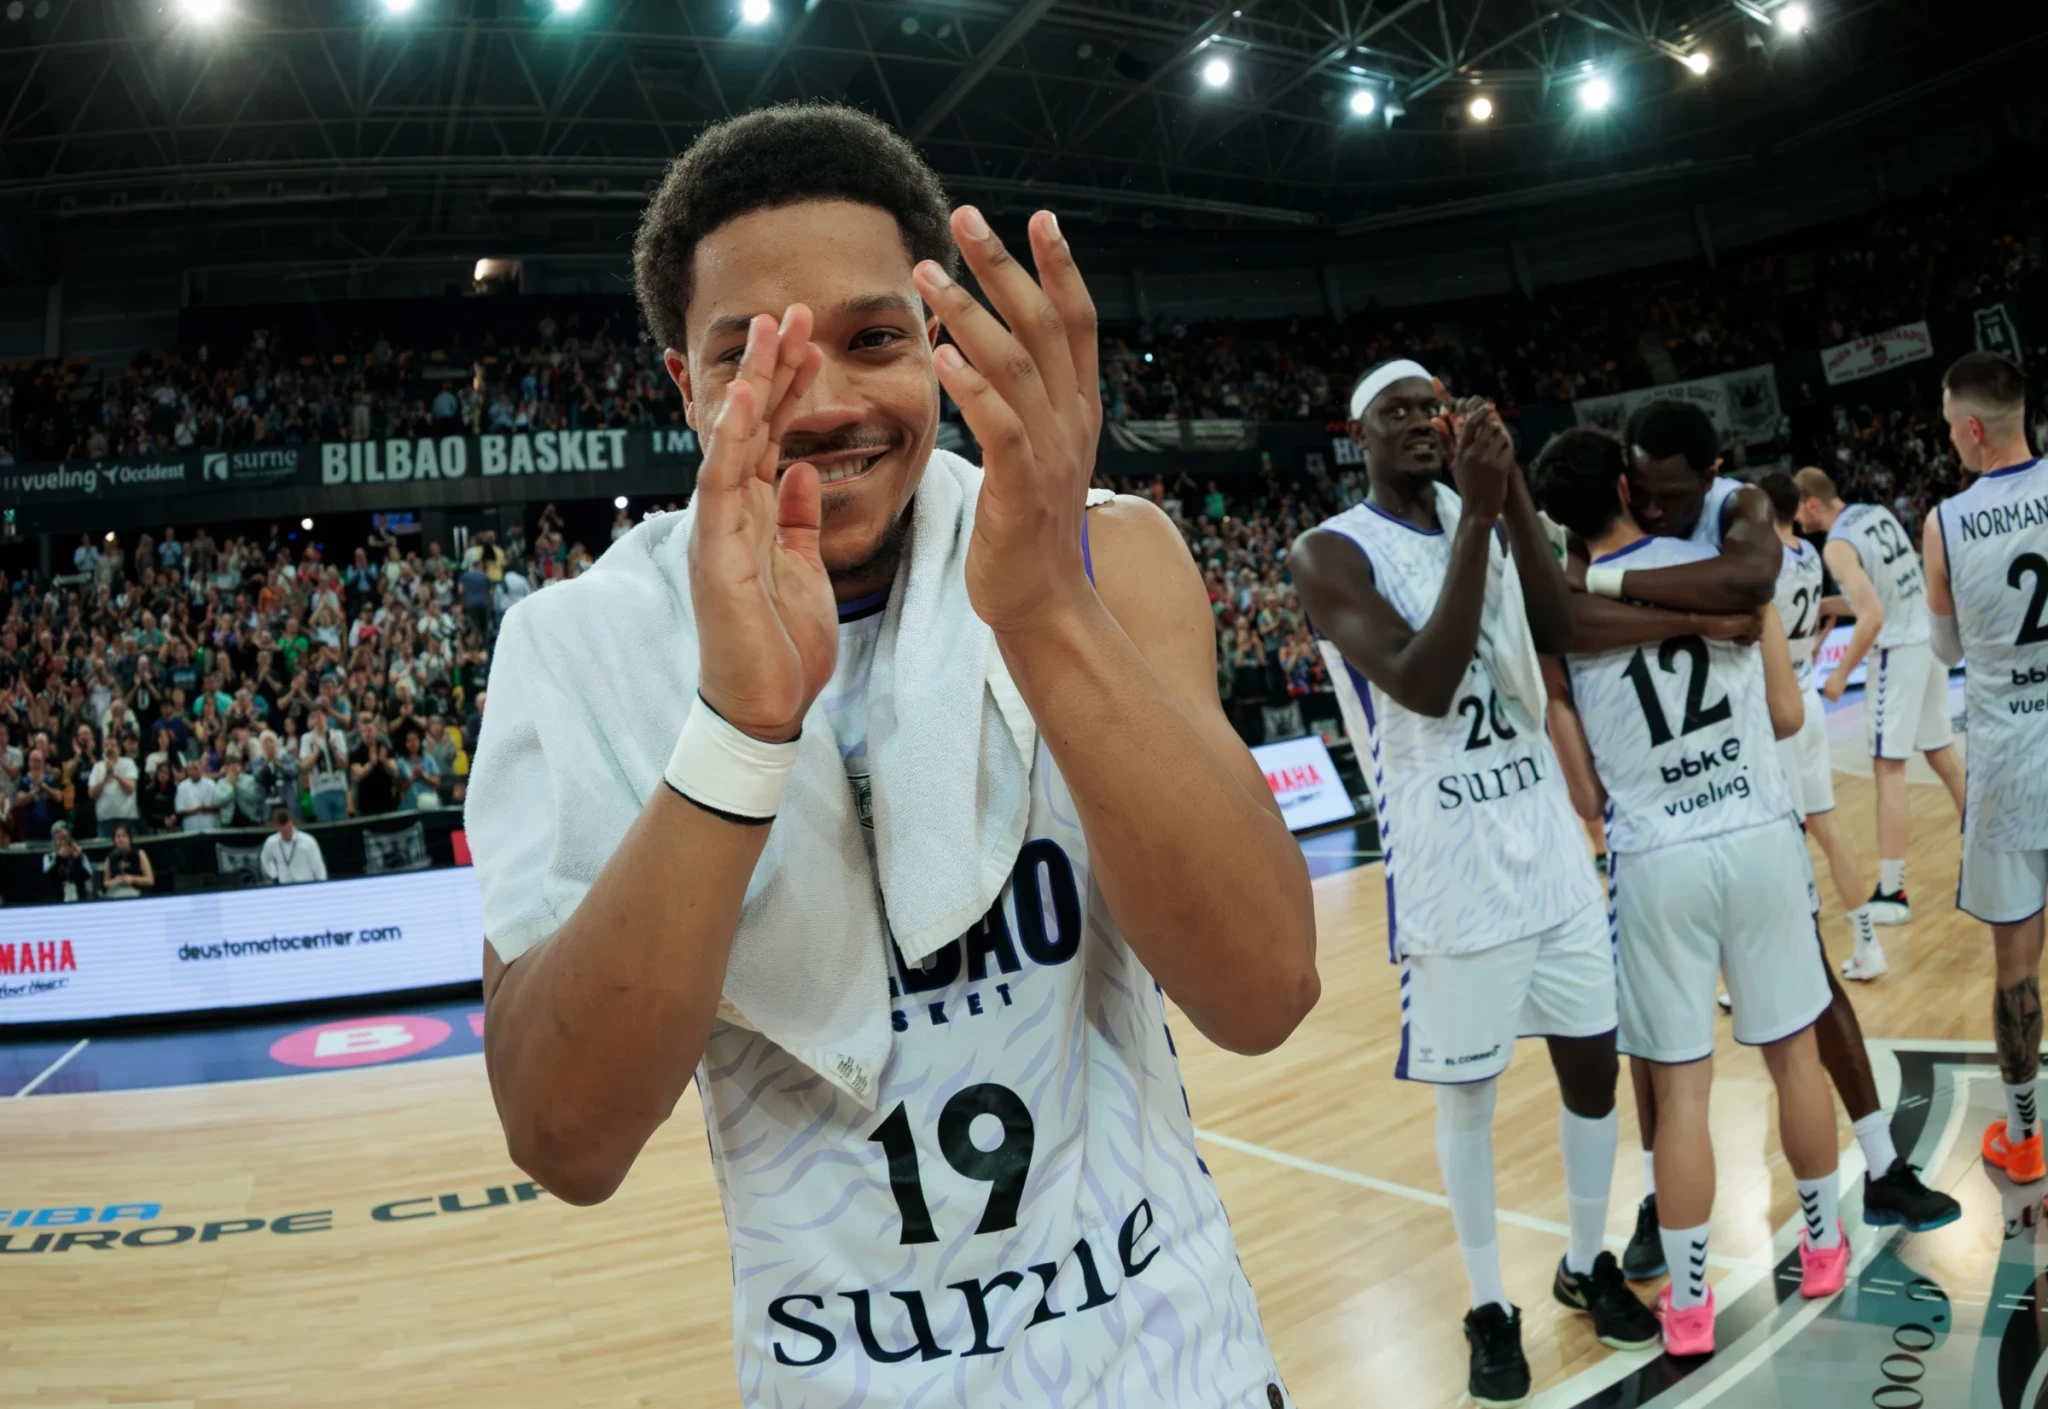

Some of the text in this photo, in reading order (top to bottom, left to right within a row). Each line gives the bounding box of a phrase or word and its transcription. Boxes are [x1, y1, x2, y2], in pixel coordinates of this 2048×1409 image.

[21, 463, 98, 493] vueling
[119, 463, 185, 483] Occident
[321, 429, 627, 485] BILBAO BASKET
[1864, 519, 1909, 565] 32
[1620, 633, 1732, 749] 12
[2011, 666, 2048, 687] bb
[1664, 775, 1751, 817] vueling
[178, 924, 402, 962] deustomotocenter.com
[867, 1082, 1035, 1246] 19
[767, 1197, 1161, 1367] surne
